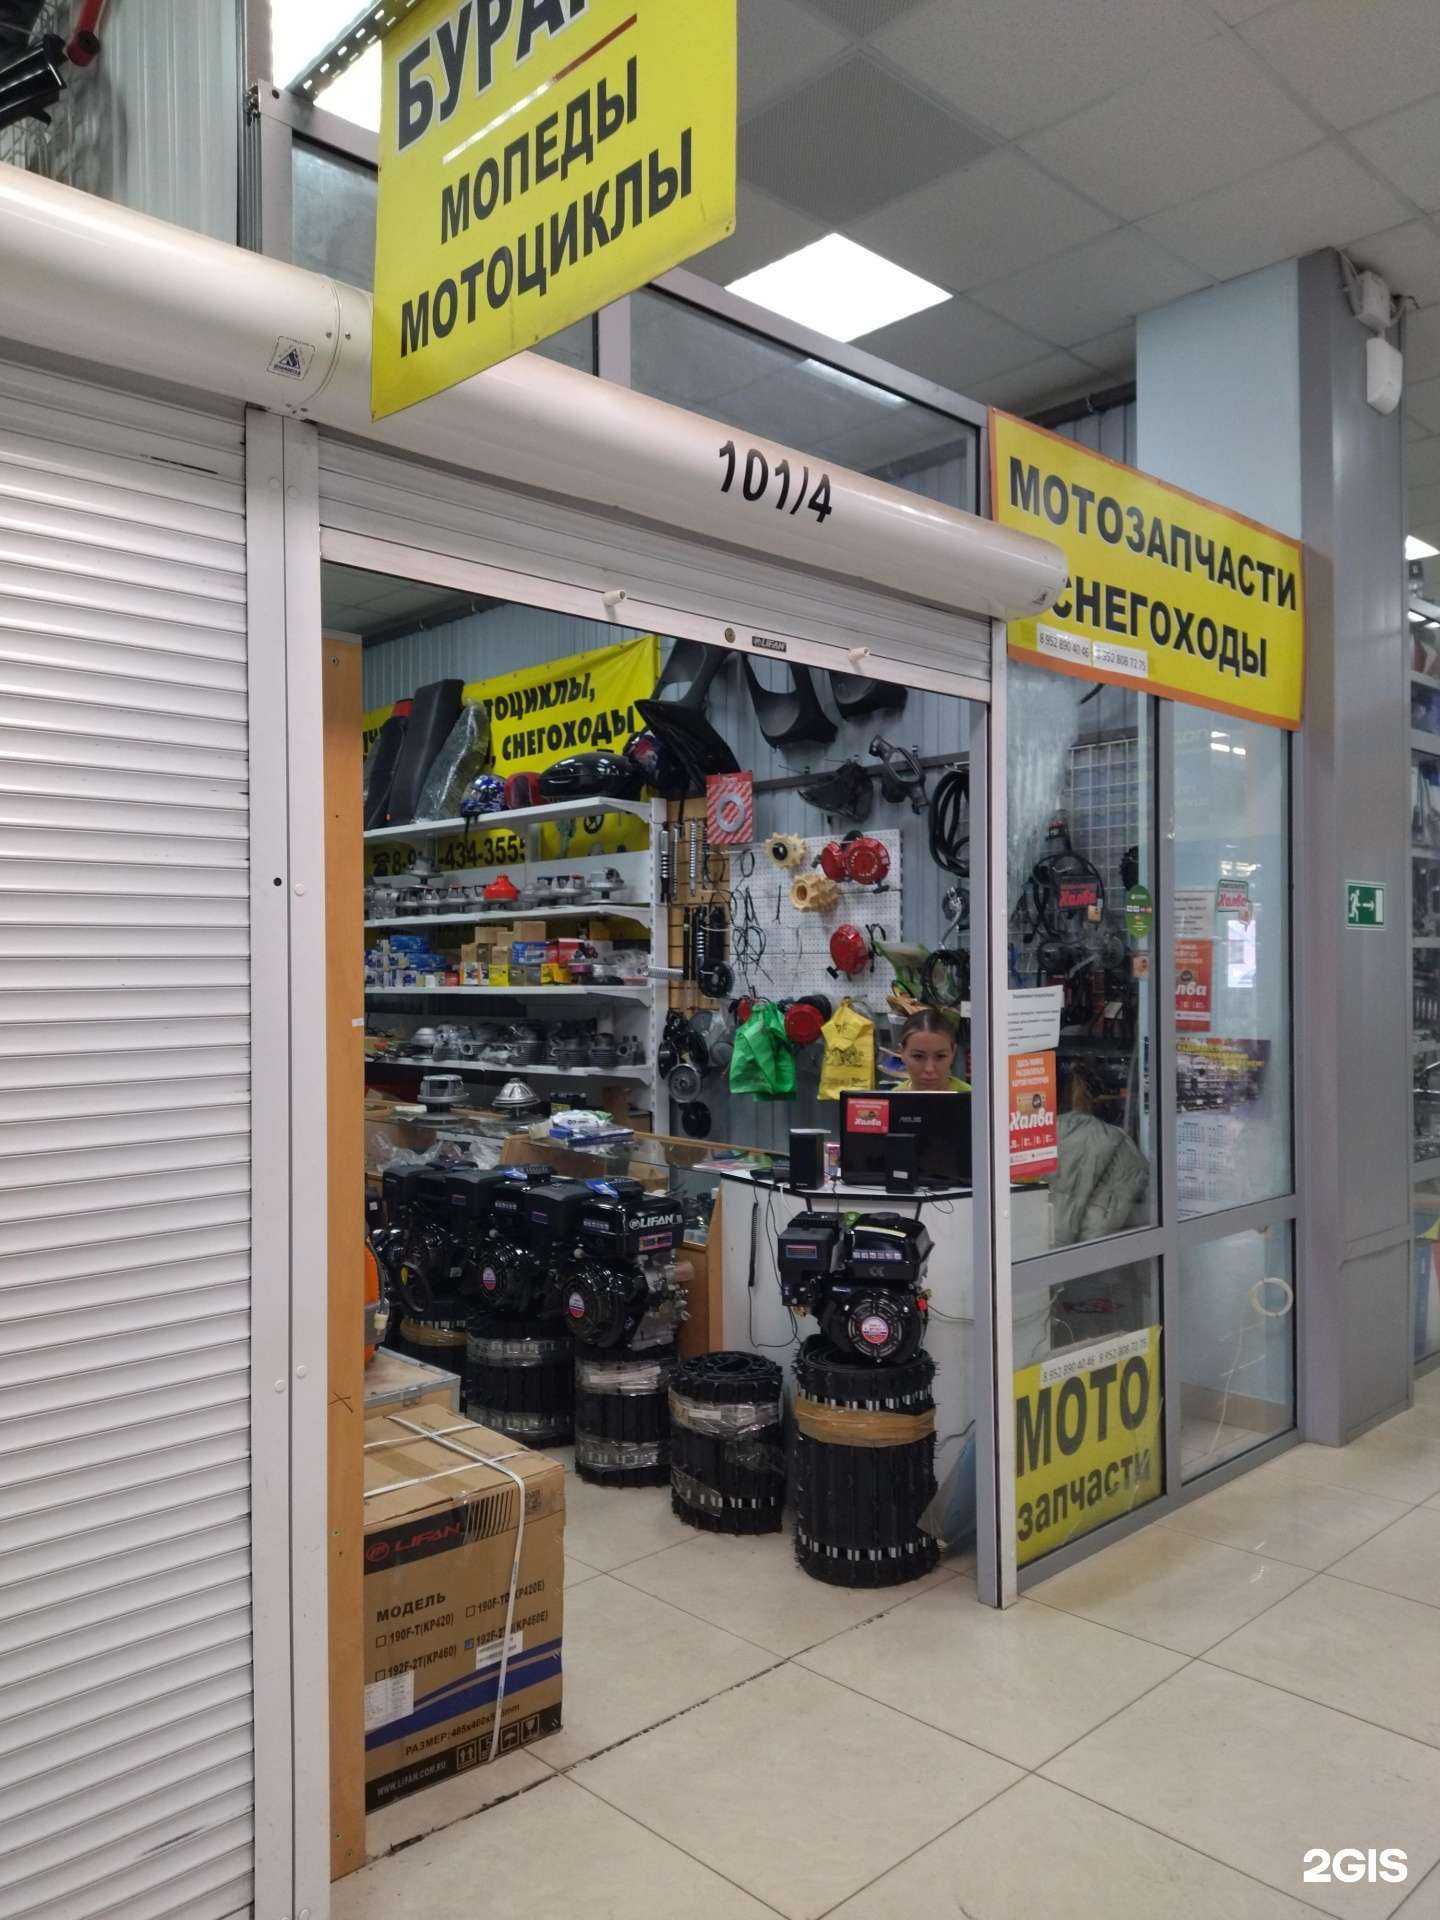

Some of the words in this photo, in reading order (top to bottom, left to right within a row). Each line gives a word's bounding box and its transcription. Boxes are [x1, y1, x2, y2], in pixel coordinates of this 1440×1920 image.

[398, 0, 586, 151] БУРА
[441, 55, 637, 245] МОПЕДЫ
[401, 127, 692, 358] МОТОЦИКЛЫ
[719, 440, 832, 523] 101/4
[1010, 456, 1296, 611] МОТОЗАПЧАСТИ
[483, 673, 595, 721] ТОЦИКЛЫ,
[502, 705, 635, 761] СНЕГОХОДЫ
[1175, 982, 1208, 997] лва
[1010, 1107, 1054, 1131] Халва
[640, 1214, 673, 1228] LIFAN
[1016, 1356, 1149, 1478] МОТО
[1017, 1448, 1150, 1542] запчасти
[376, 1592, 446, 1623] МОДЕЛЬ
